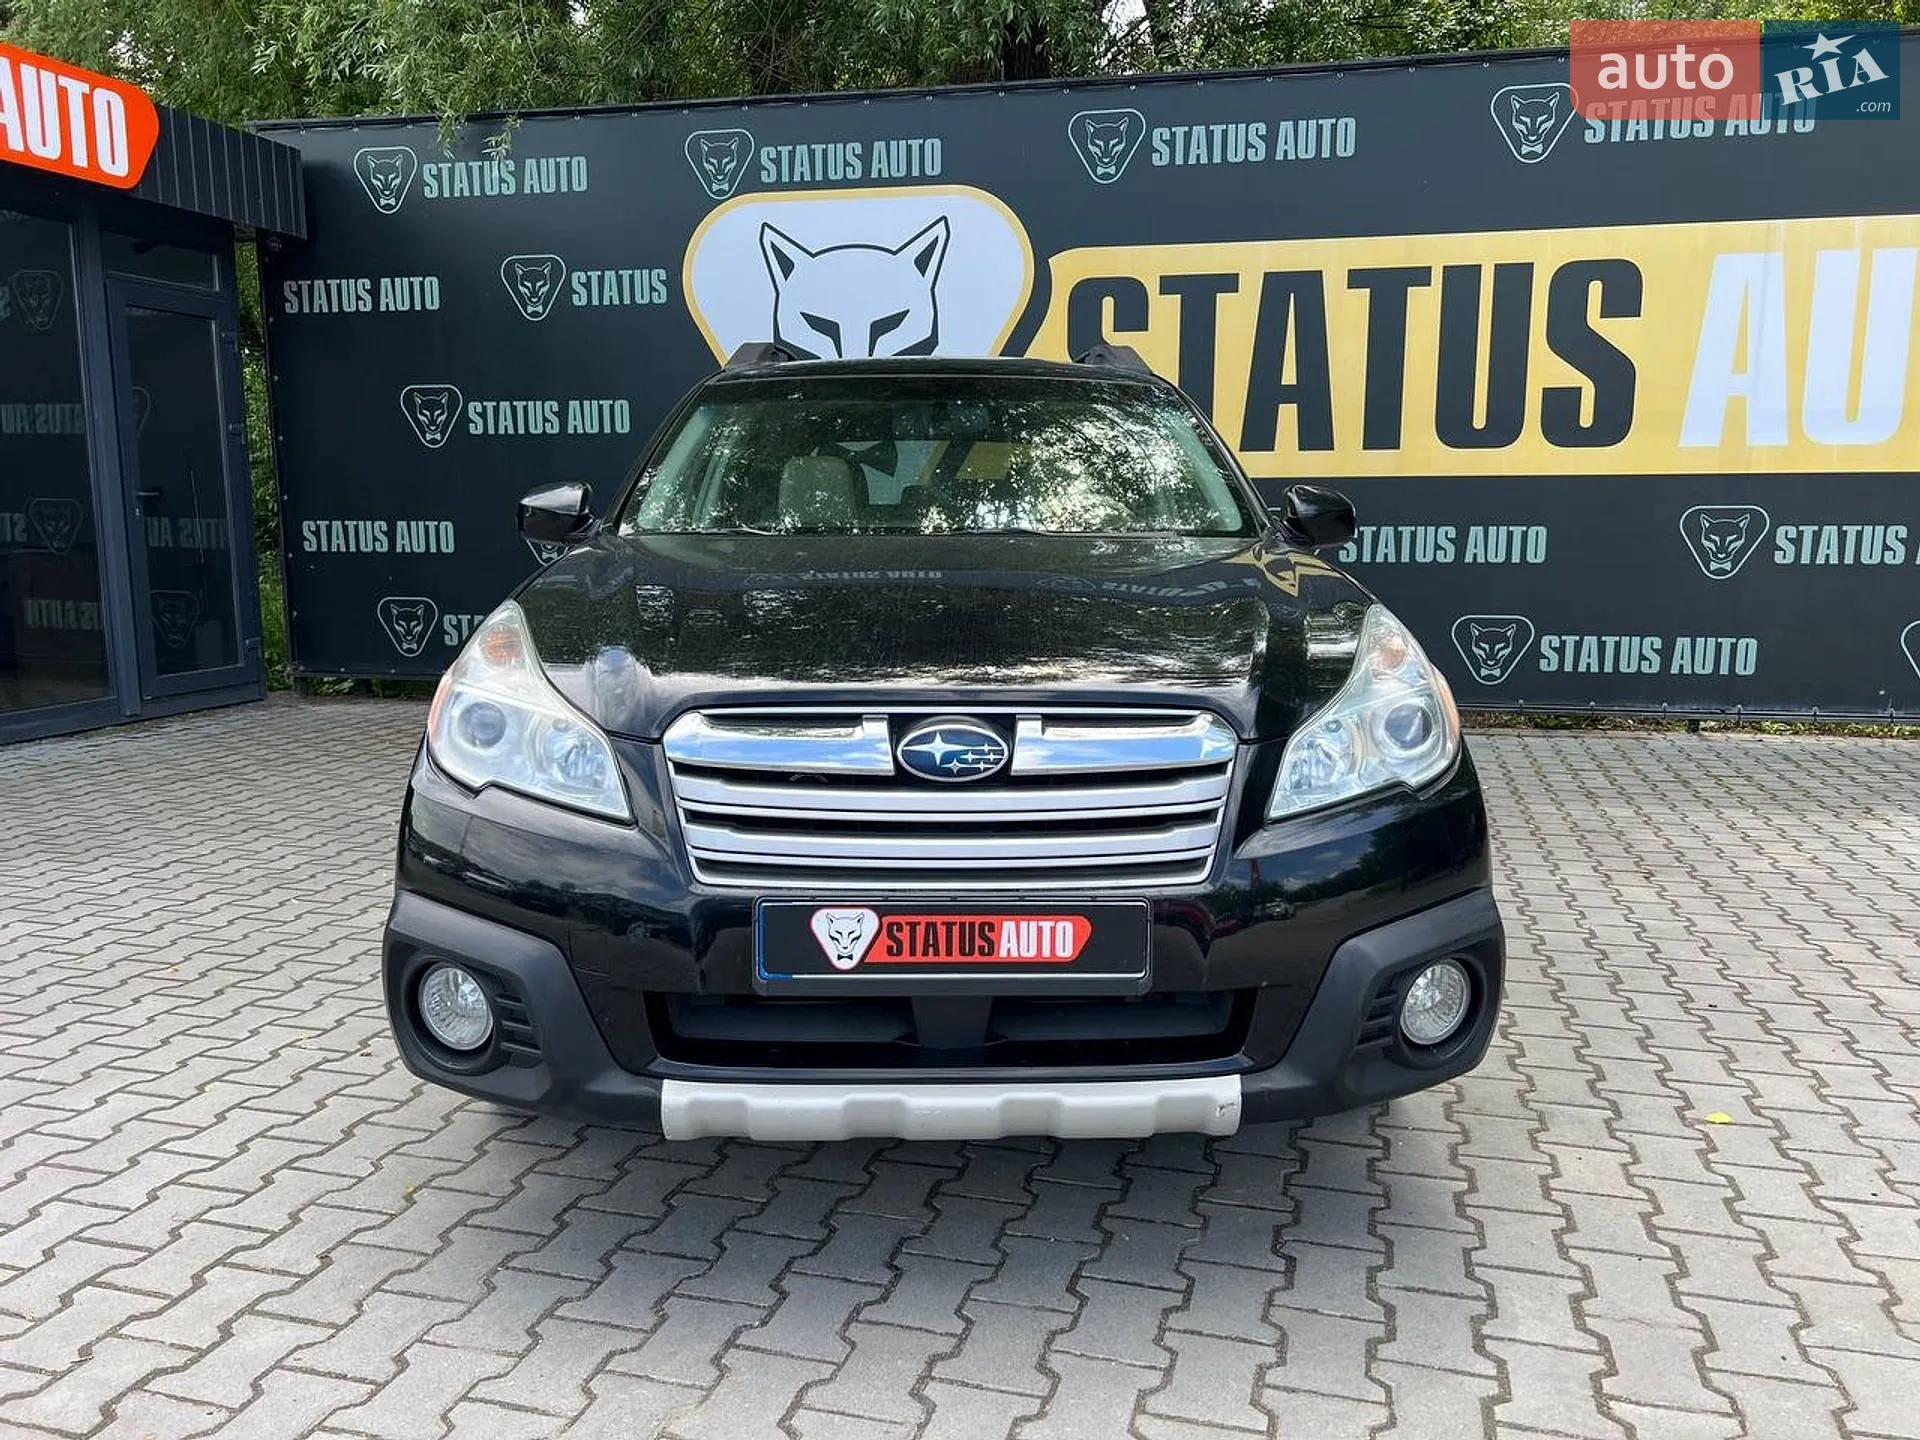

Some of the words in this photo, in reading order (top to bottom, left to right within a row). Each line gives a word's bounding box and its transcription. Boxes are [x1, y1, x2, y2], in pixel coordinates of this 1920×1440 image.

[0, 56, 129, 178] AUTO
[1584, 93, 1716, 144] STATUS
[760, 142, 862, 183] STATUS
[870, 137, 942, 179] AUTO
[1151, 121, 1265, 166] STATUS
[1275, 117, 1356, 161] AUTO
[422, 159, 516, 199] STATUS
[523, 156, 588, 194] AUTO
[283, 278, 373, 314] STATUS
[379, 276, 440, 312] AUTO
[571, 268, 667, 306] STATUS
[1680, 247, 1917, 447] AU
[467, 400, 559, 435] STATUS
[567, 399, 630, 434] AUTO
[302, 520, 388, 553] STATUS
[395, 520, 455, 553] AUTO
[1464, 526, 1548, 564] AUTO
[1774, 525, 1908, 565] STATUS
[1539, 635, 1660, 674] STATUS
[1669, 636, 1758, 676] AUTO
[886, 920, 996, 957] STATUS
[999, 920, 1074, 958] AUTO
